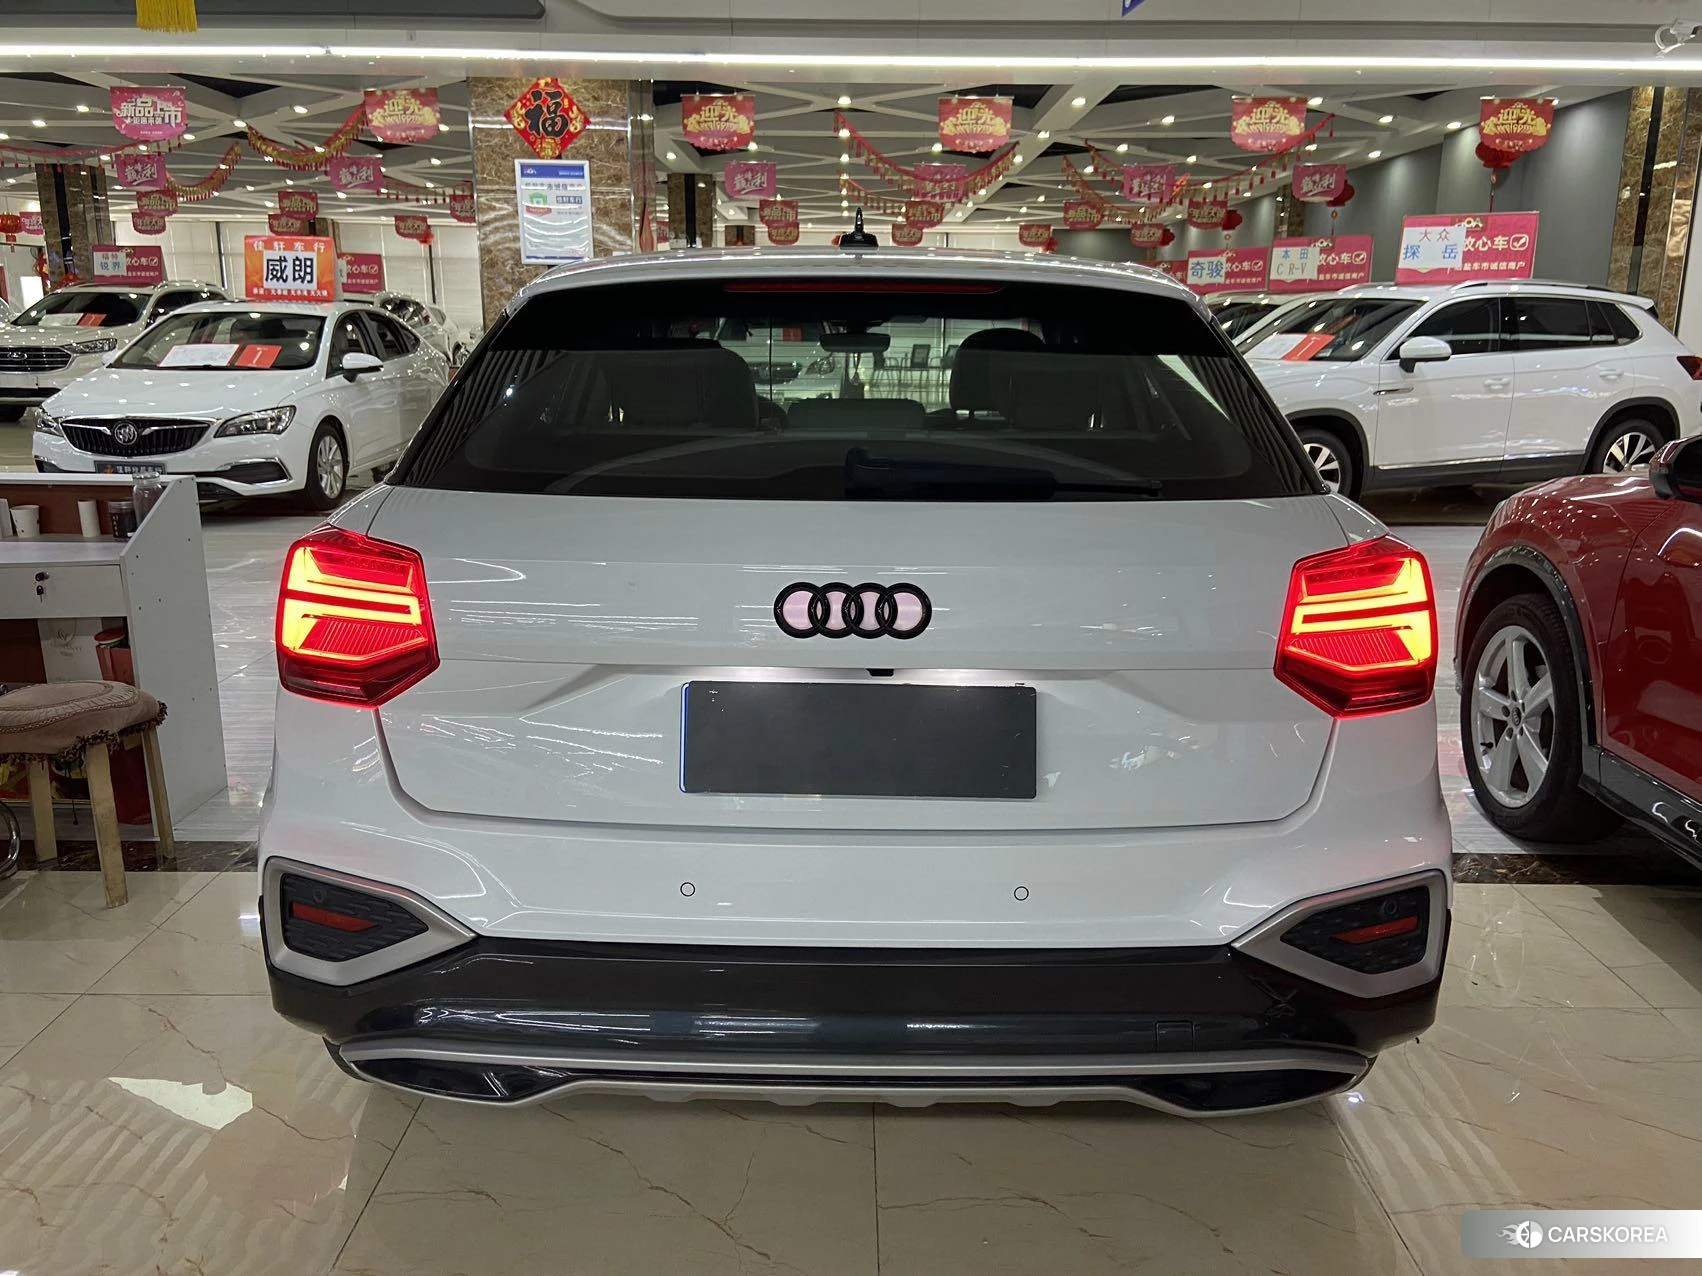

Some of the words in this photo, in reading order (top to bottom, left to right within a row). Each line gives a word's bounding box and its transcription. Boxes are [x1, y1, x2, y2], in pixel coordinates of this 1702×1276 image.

[119, 96, 182, 128] 新品上市
[524, 89, 569, 138] 福
[1421, 229, 1449, 241] 大众
[1282, 248, 1308, 260] 本田
[1403, 244, 1458, 260] 探岳
[265, 256, 313, 283] 威朗
[1191, 260, 1224, 278] 奇骏
